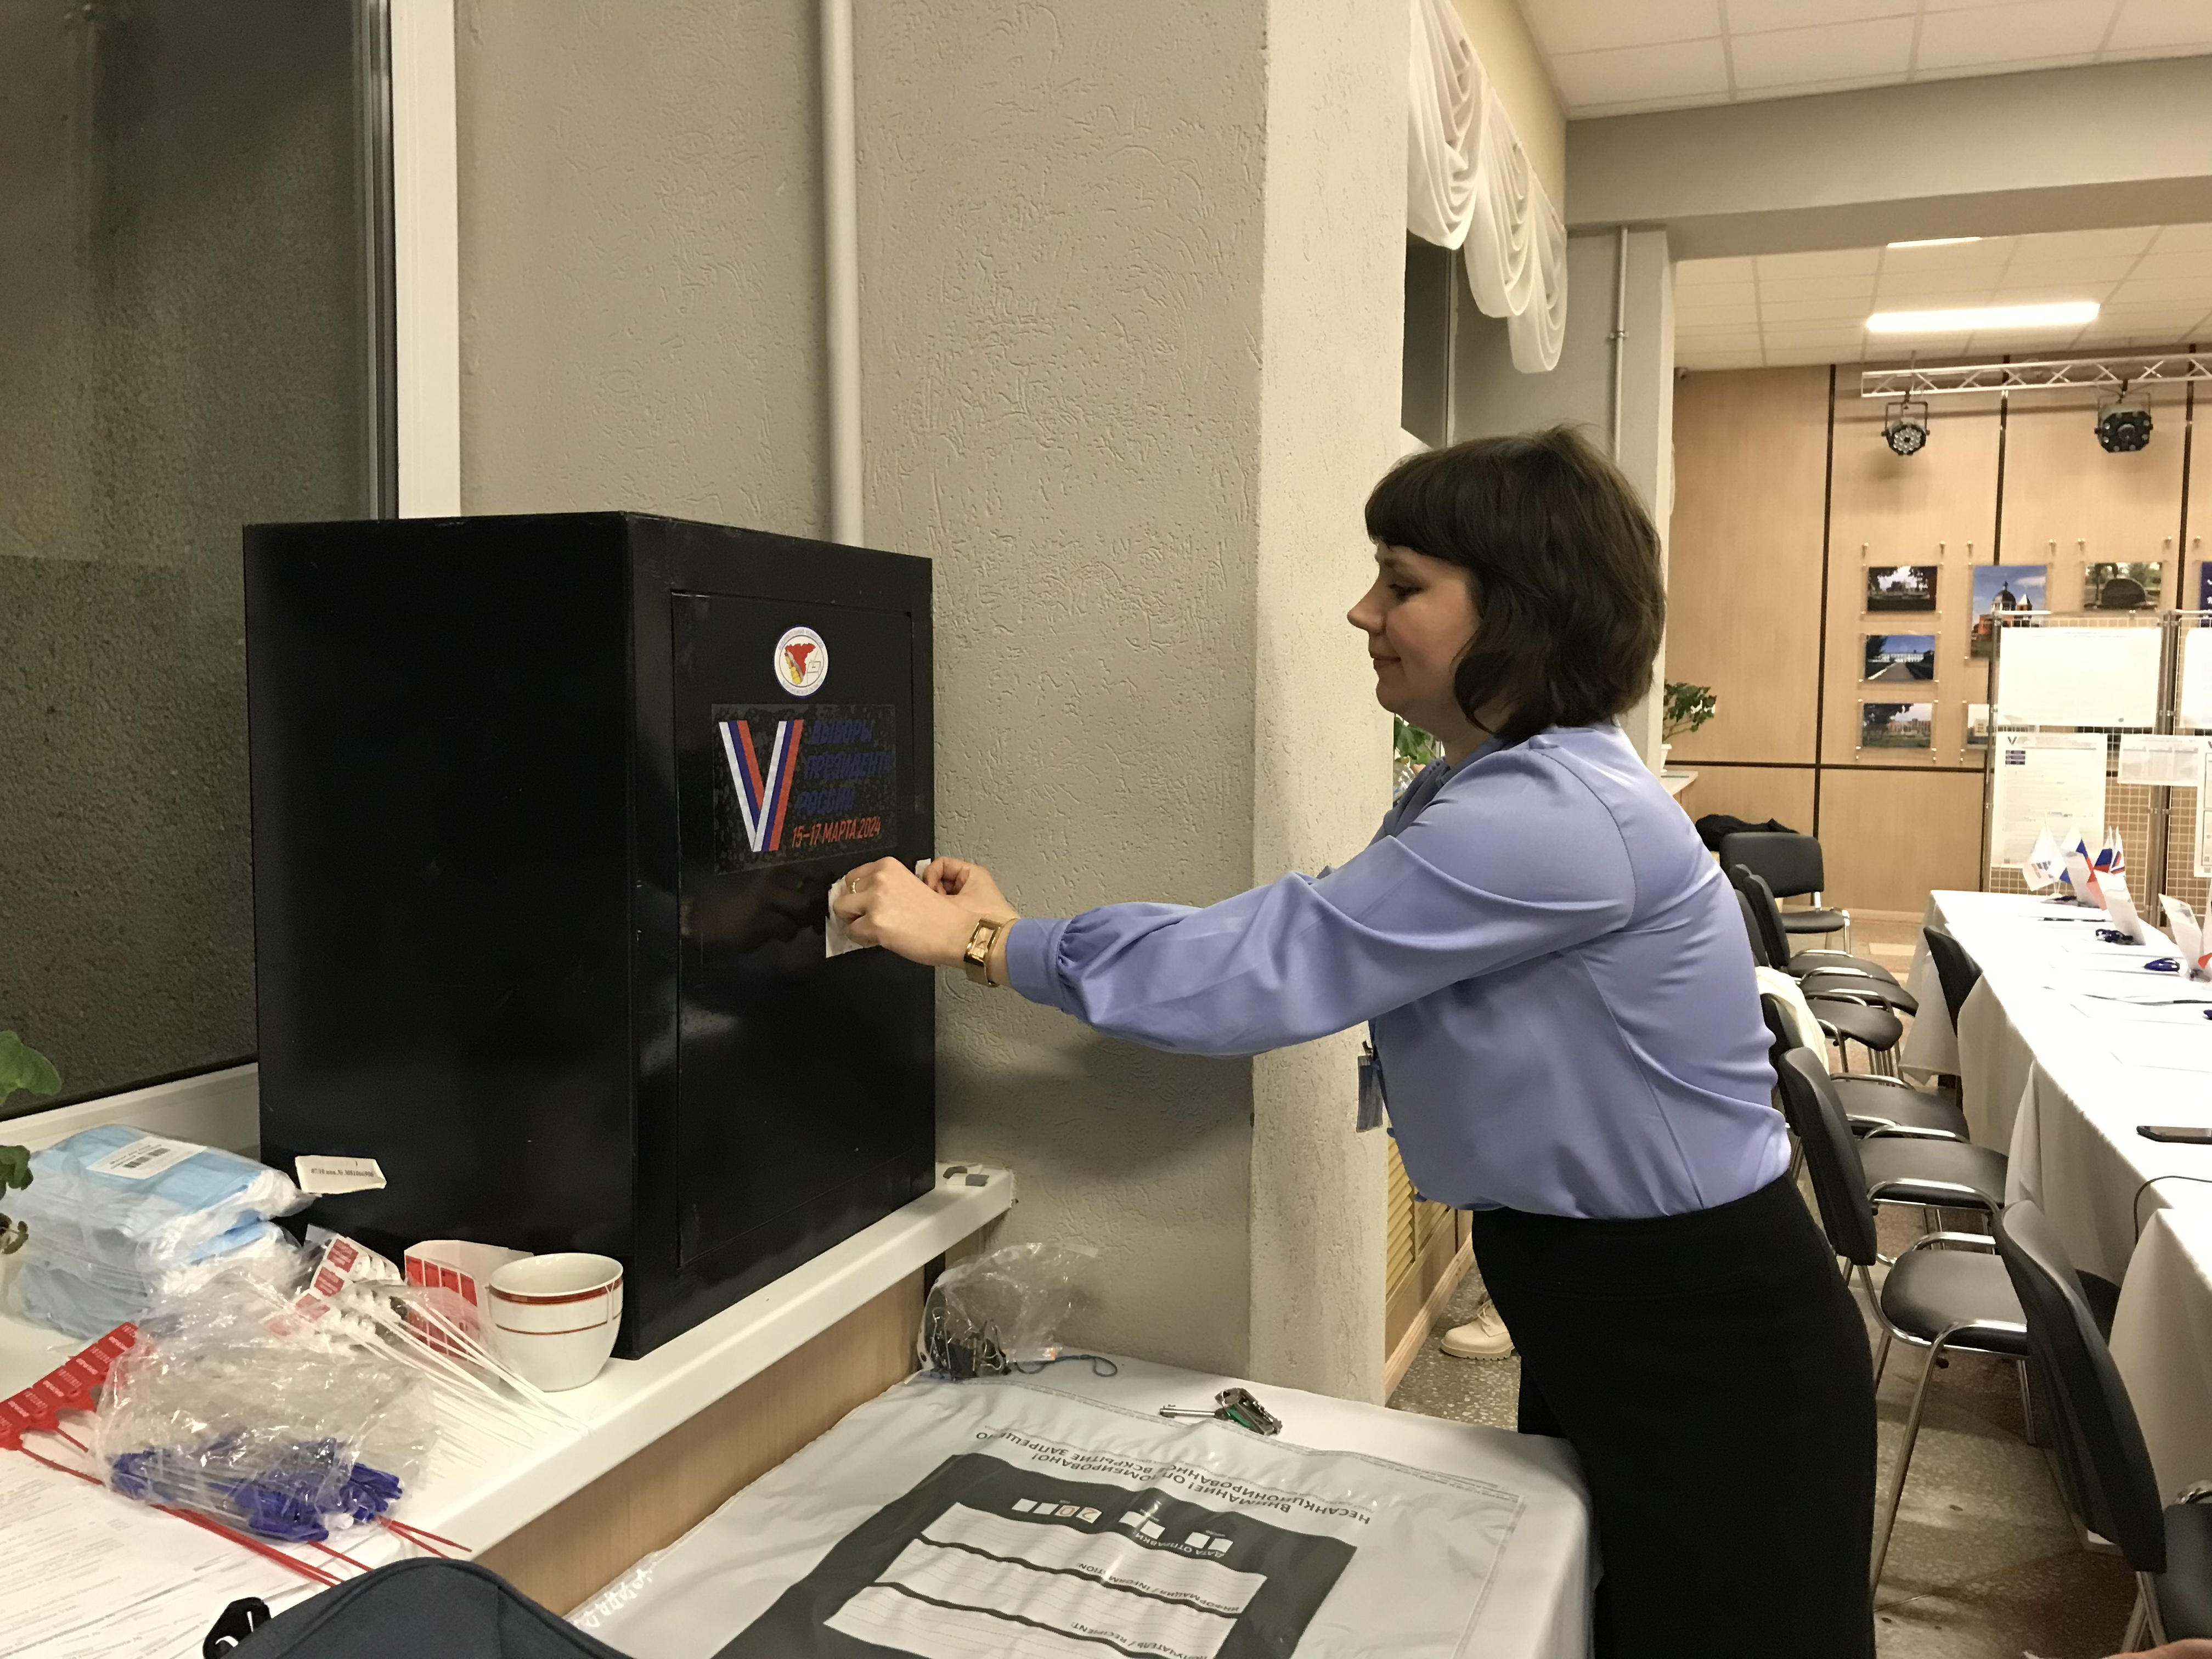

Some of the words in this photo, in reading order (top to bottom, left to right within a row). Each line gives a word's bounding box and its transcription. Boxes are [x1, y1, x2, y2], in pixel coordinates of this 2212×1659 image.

[811, 720, 872, 744] ВЫБОРЫ
[797, 787, 855, 817] РОССИИ
[822, 819, 857, 844] МАРТА
[857, 816, 881, 838] 2024
[1070, 1453, 1153, 1474] ВСКРЫТИЕ
[1188, 1482, 1291, 1513] ВНИМАНИЕ!
[1196, 1549, 1224, 1558] ДАТА
[1076, 1562, 1150, 1591] INFORMTION:
[1160, 1589, 1239, 1612] ИНФОРМАЦИЯ
